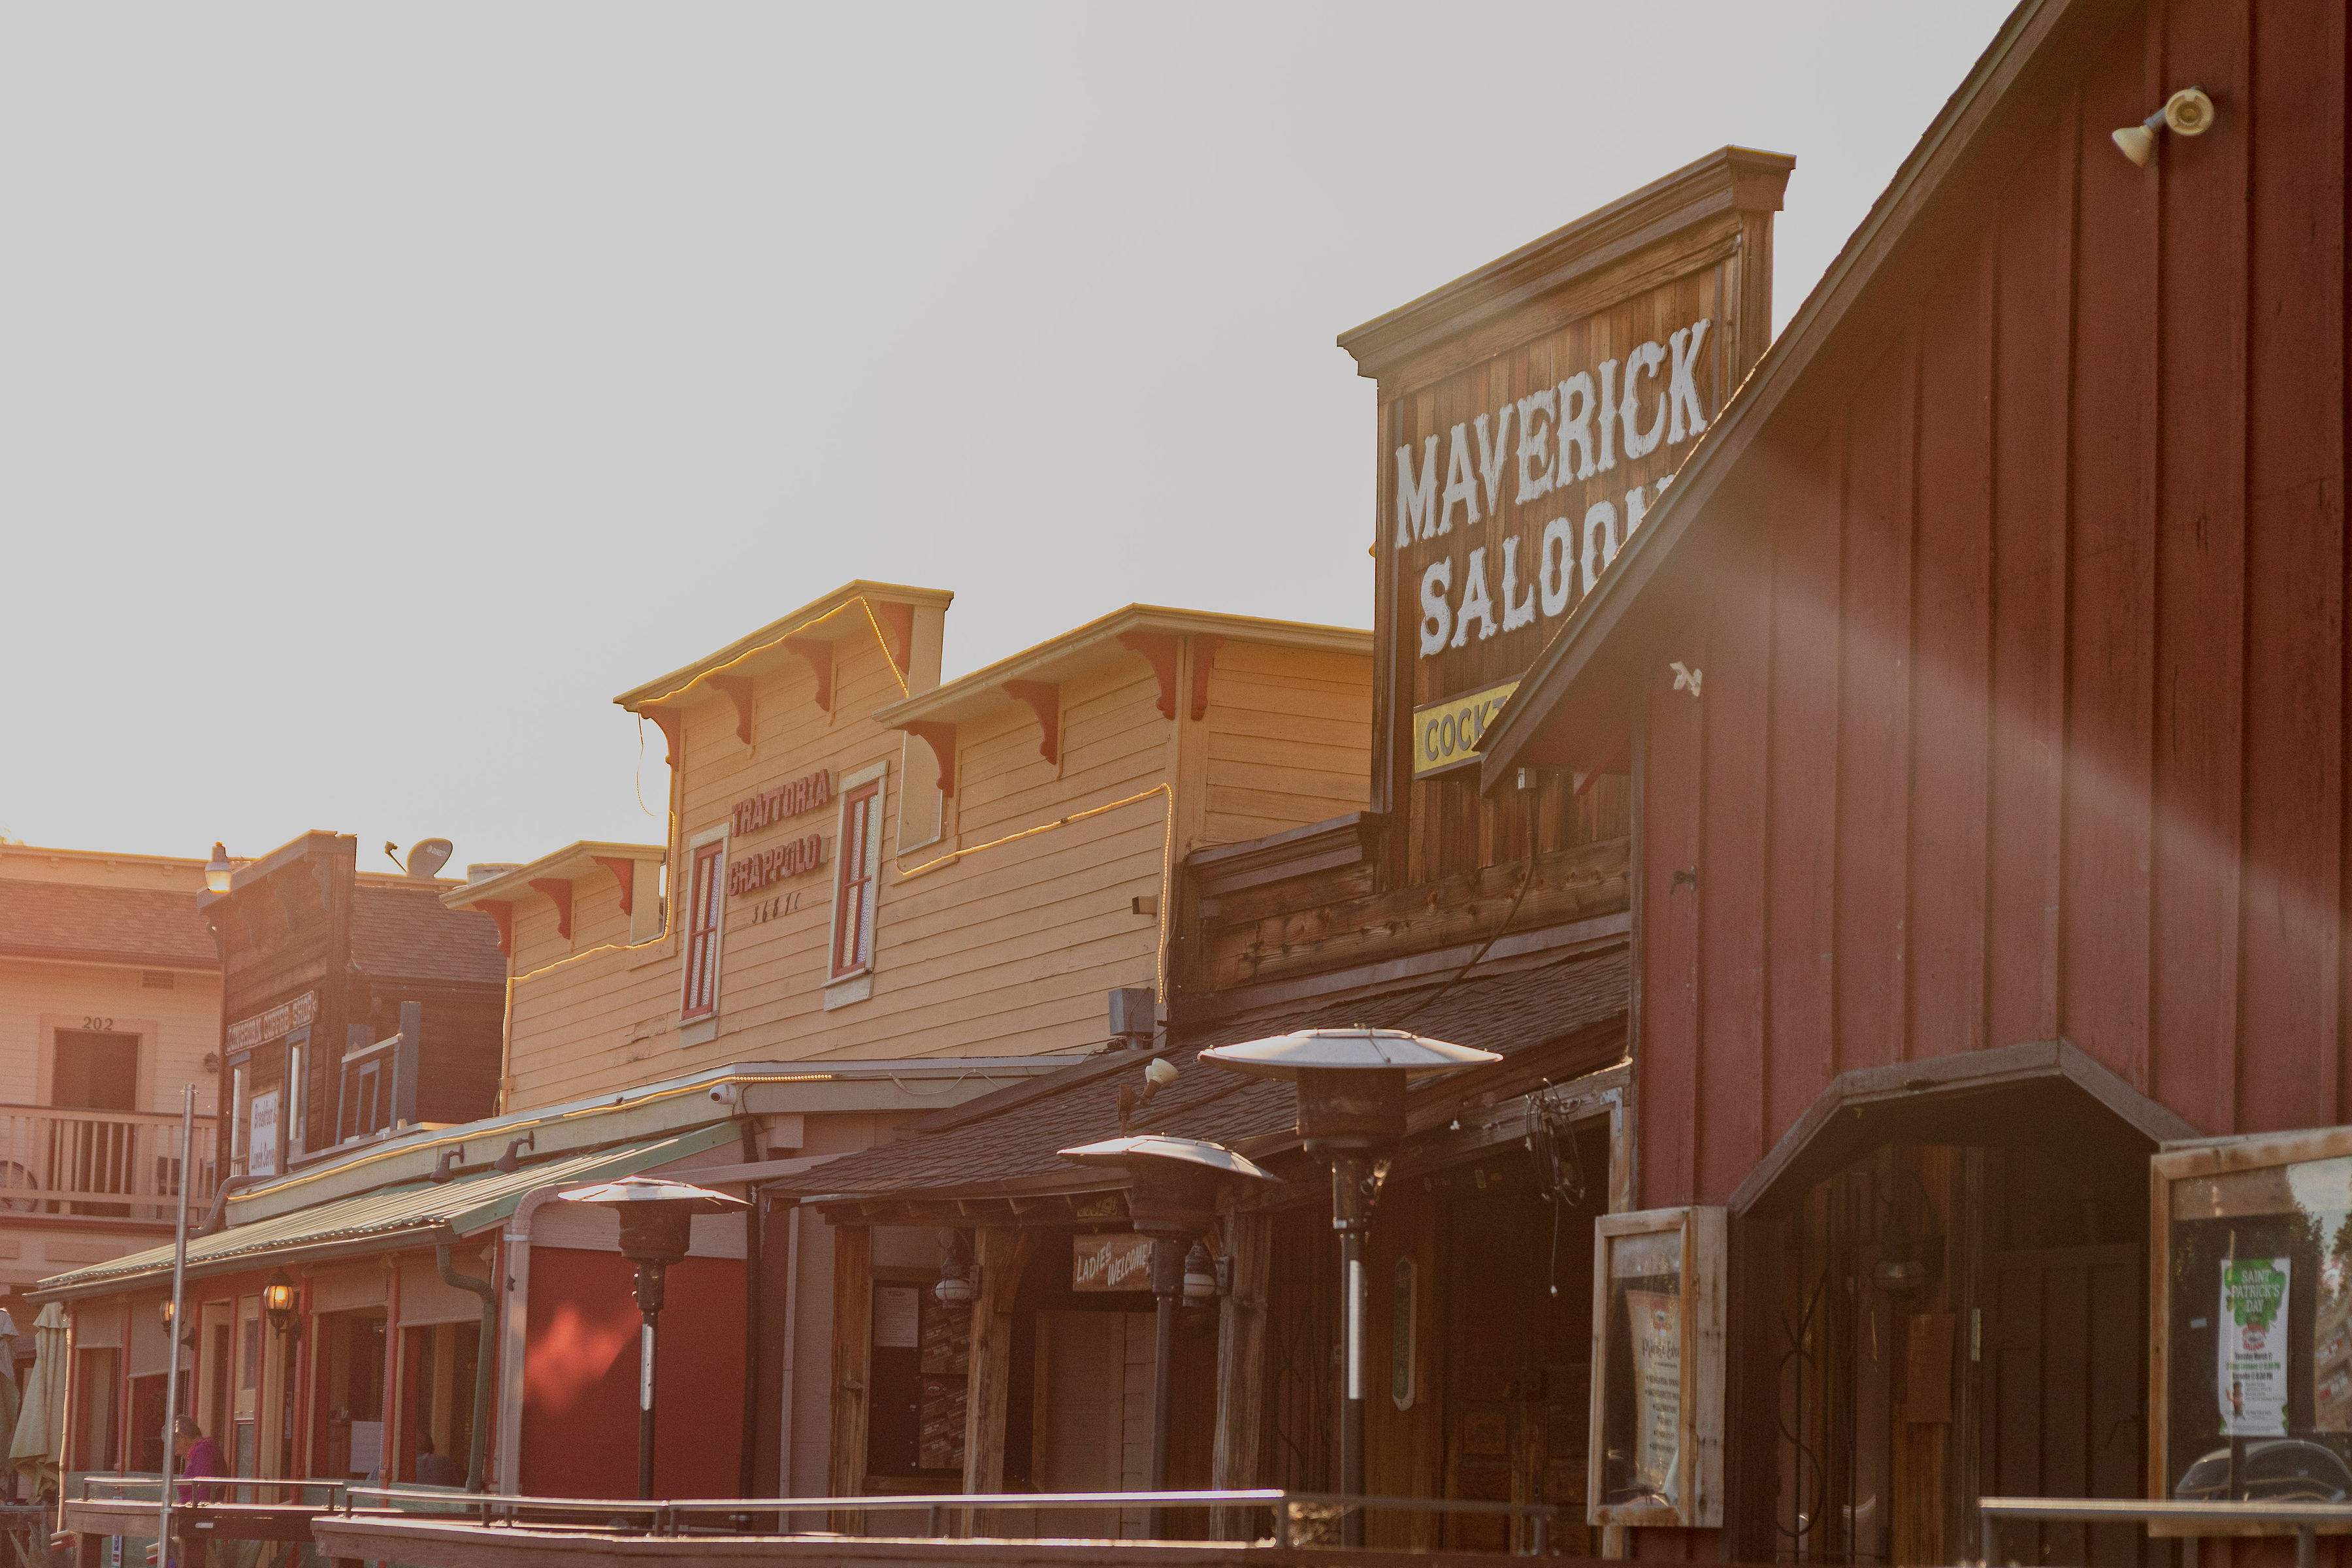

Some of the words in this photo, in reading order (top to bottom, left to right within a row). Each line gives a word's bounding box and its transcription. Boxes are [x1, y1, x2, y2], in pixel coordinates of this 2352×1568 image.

[1395, 318, 1712, 549] MAVERICK
[732, 768, 830, 838] TRATTORIA
[728, 834, 822, 896] GRAPPOLO
[82, 1016, 114, 1031] 202
[263, 1005, 289, 1040] COFFEE
[292, 994, 312, 1028] SHOP
[1077, 1241, 1111, 1283] LADIES
[2242, 1269, 2272, 1283] SAINT
[2230, 1284, 2281, 1298] PATRICK'S
[2246, 1299, 2264, 1313] DAY
